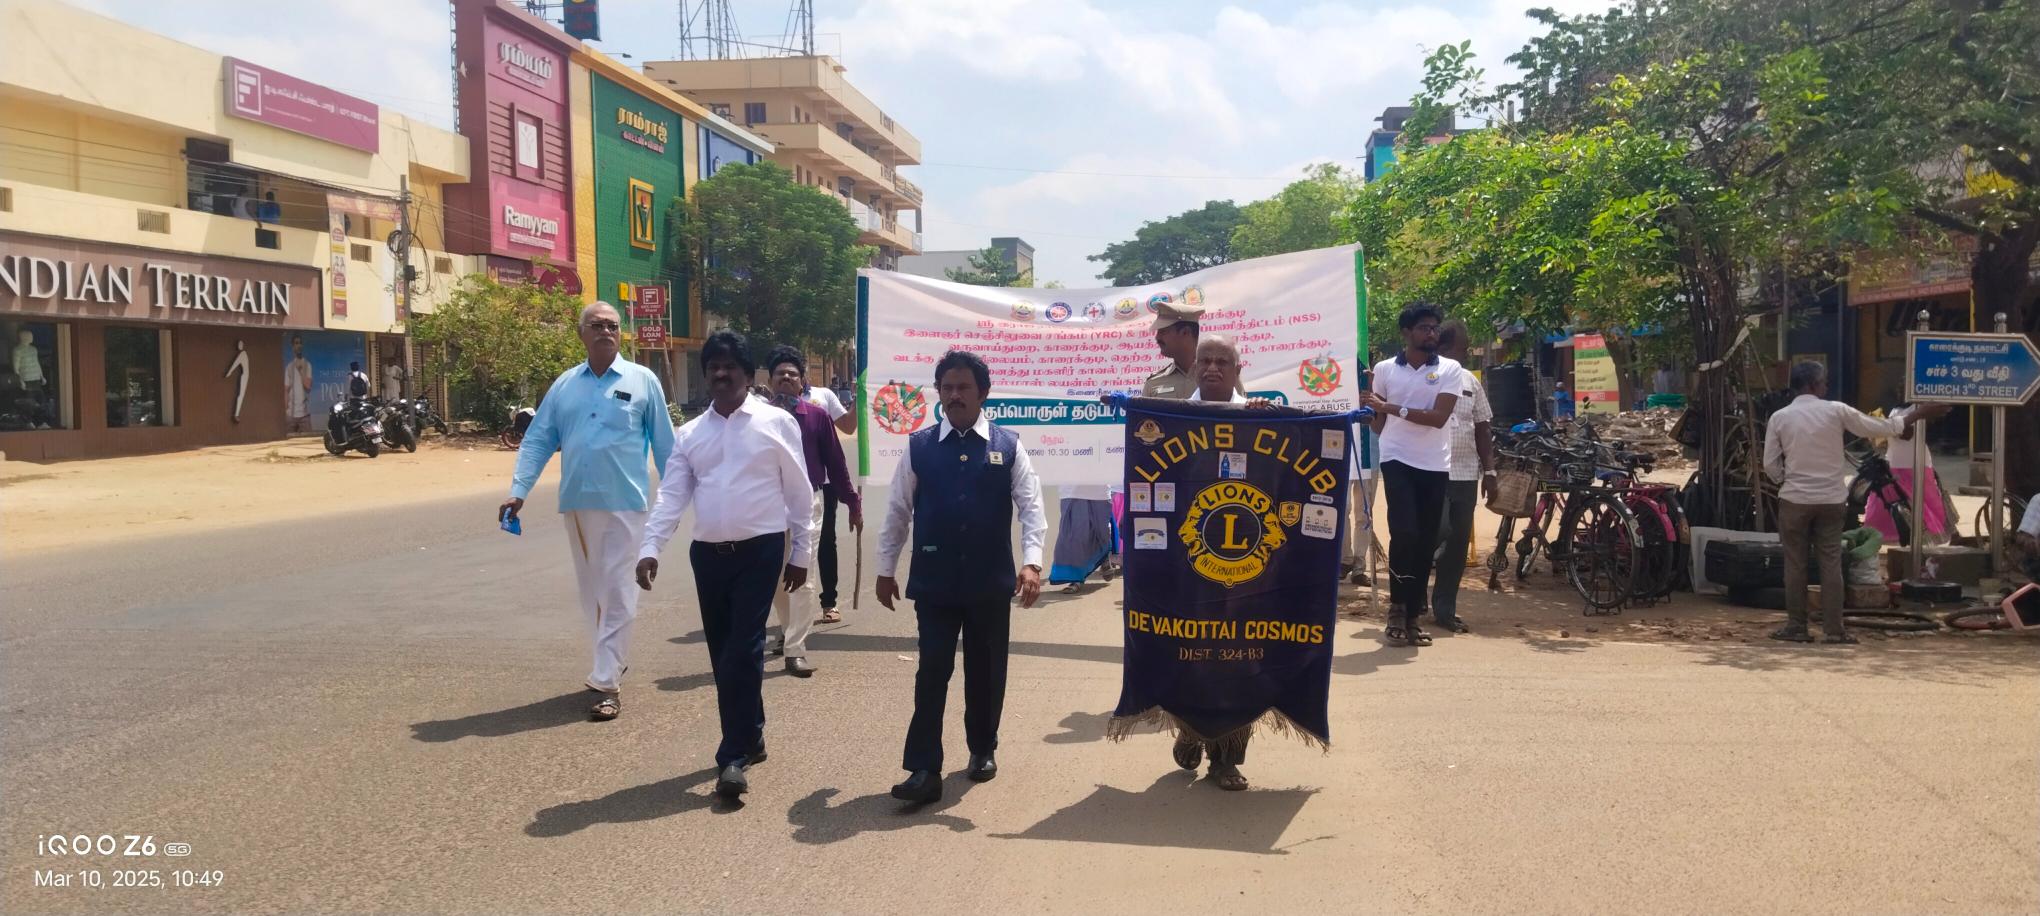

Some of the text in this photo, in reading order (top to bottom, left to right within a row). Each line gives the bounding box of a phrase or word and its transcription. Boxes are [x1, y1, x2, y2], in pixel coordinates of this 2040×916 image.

[618, 107, 668, 144] ராம்ராஜ்
[505, 205, 558, 236] Ramyyam
[1090, 330, 1122, 339] (YRC)
[1126, 329, 1135, 338] &
[1288, 313, 1321, 326] (NSS)
[1951, 366, 1959, 377] 3
[1961, 367, 1984, 382] வது
[1915, 383, 1960, 395] CHURCH
[1977, 386, 2019, 396] STREET
[1320, 402, 1351, 411] ABUSE
[1047, 448, 1069, 456] 10.30
[1134, 423, 1337, 494] LIONS CLUB
[1202, 485, 1267, 511] LIONS
[1221, 513, 1249, 550] L
[1200, 556, 1259, 577] INTERNATIONAL
[1244, 620, 1324, 644] COSMOS
[1218, 647, 1264, 661] 324-B3
